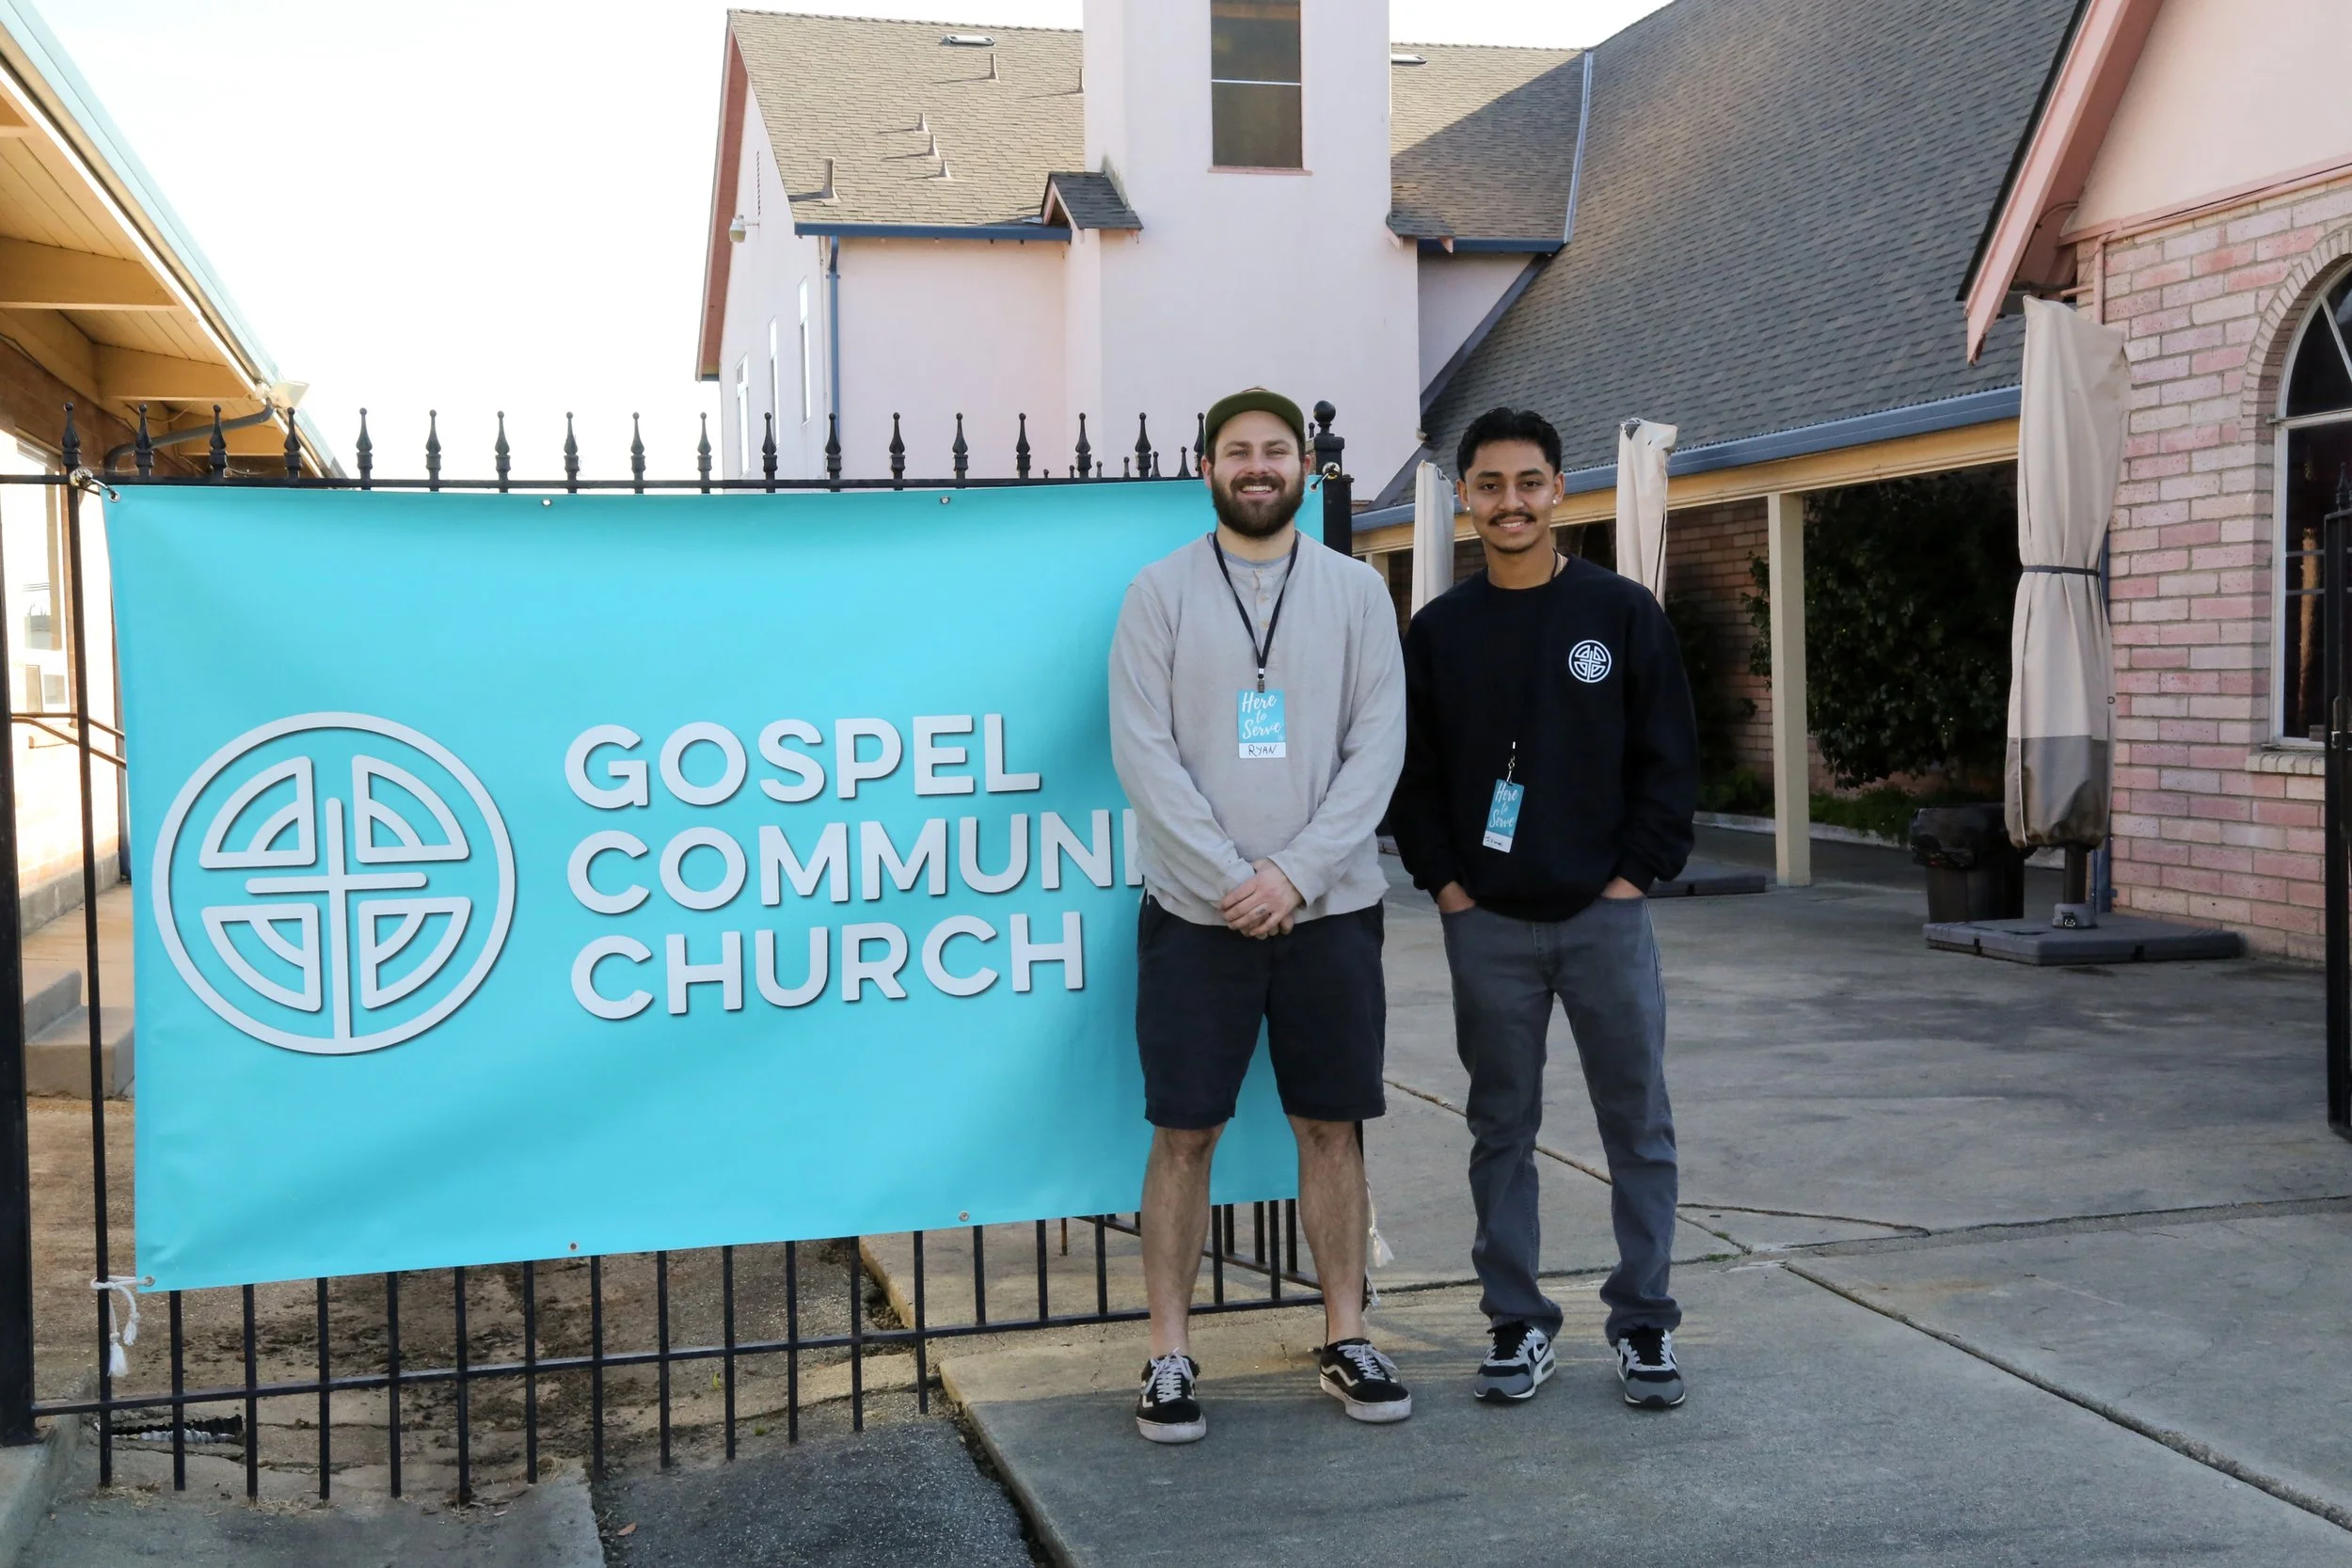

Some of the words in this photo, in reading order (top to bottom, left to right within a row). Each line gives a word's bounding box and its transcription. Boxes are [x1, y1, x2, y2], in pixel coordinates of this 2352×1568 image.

[1242, 691, 1278, 714] Here
[1256, 709, 1267, 723] to
[1242, 719, 1281, 739] Serve
[1248, 744, 1278, 757] RYAN
[564, 713, 1041, 809] GOSPEL
[1495, 783, 1518, 802] Here
[1489, 809, 1515, 829] Serve
[567, 808, 1144, 914] COMMUNI
[570, 911, 1085, 1020] CHURCH
